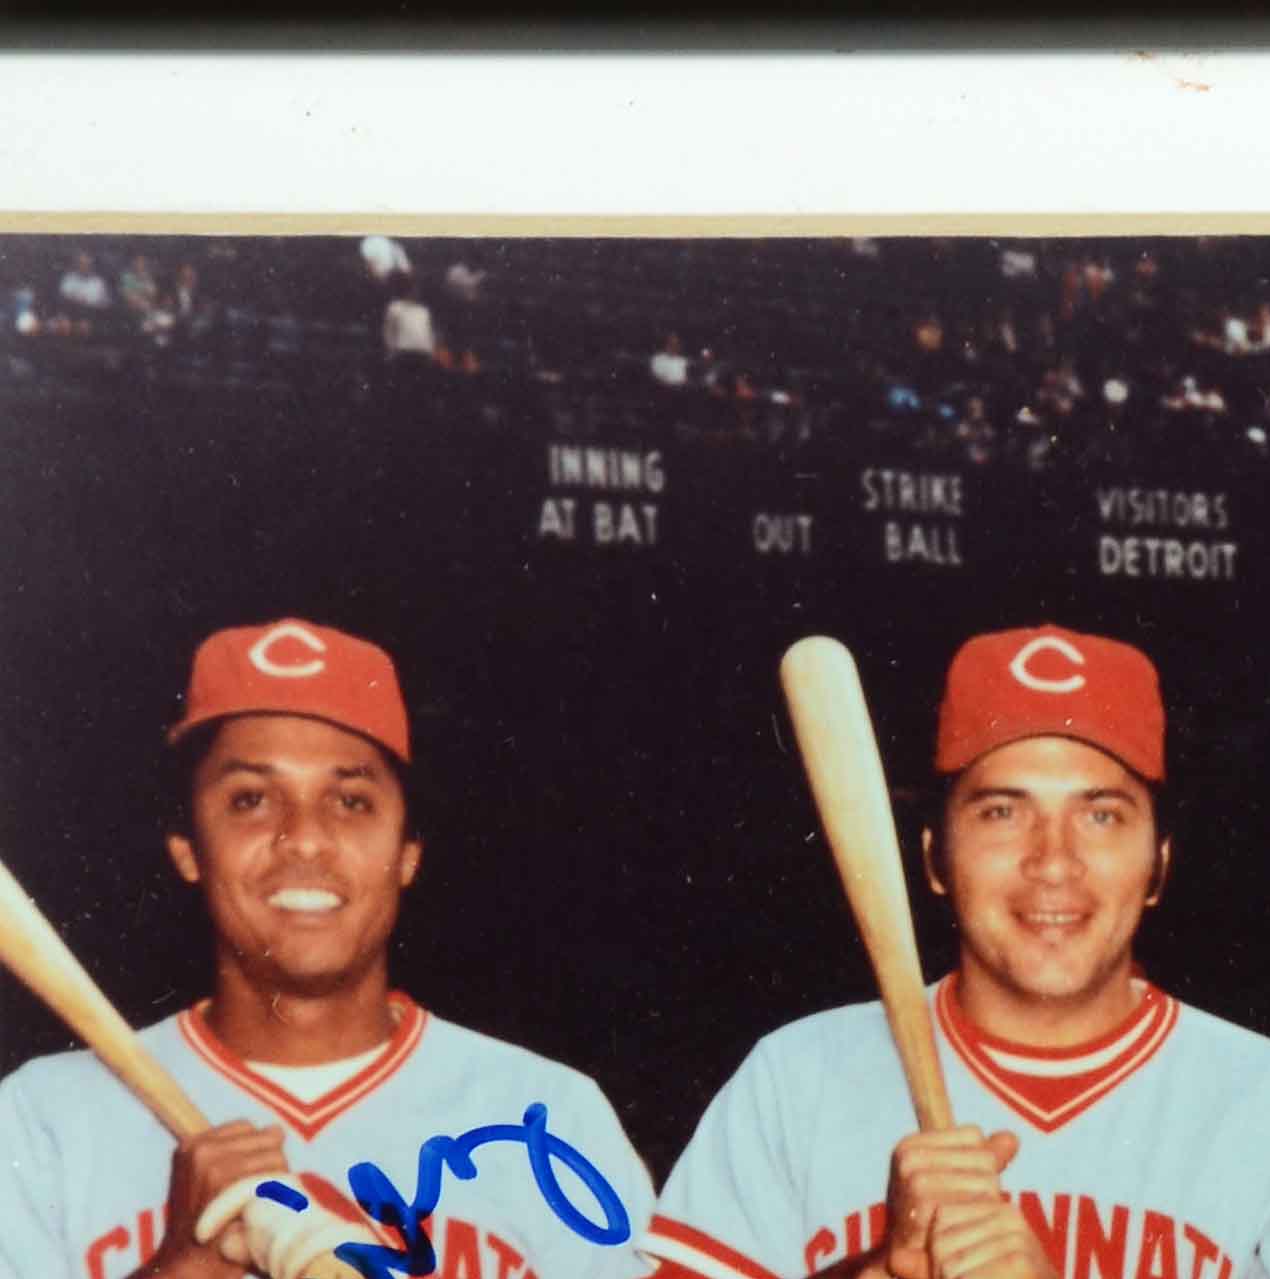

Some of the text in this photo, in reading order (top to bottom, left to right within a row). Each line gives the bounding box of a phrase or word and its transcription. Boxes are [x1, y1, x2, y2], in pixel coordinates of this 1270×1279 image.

[547, 444, 665, 493] INNING
[862, 468, 963, 517] STRIKE
[539, 497, 658, 545] AT BAT
[752, 512, 812, 553] OUT
[1098, 488, 1229, 530] VISITORS
[884, 521, 963, 566] BALL
[1099, 536, 1237, 581] DETROIT
[250, 624, 326, 678] C
[1009, 634, 1087, 693] C
